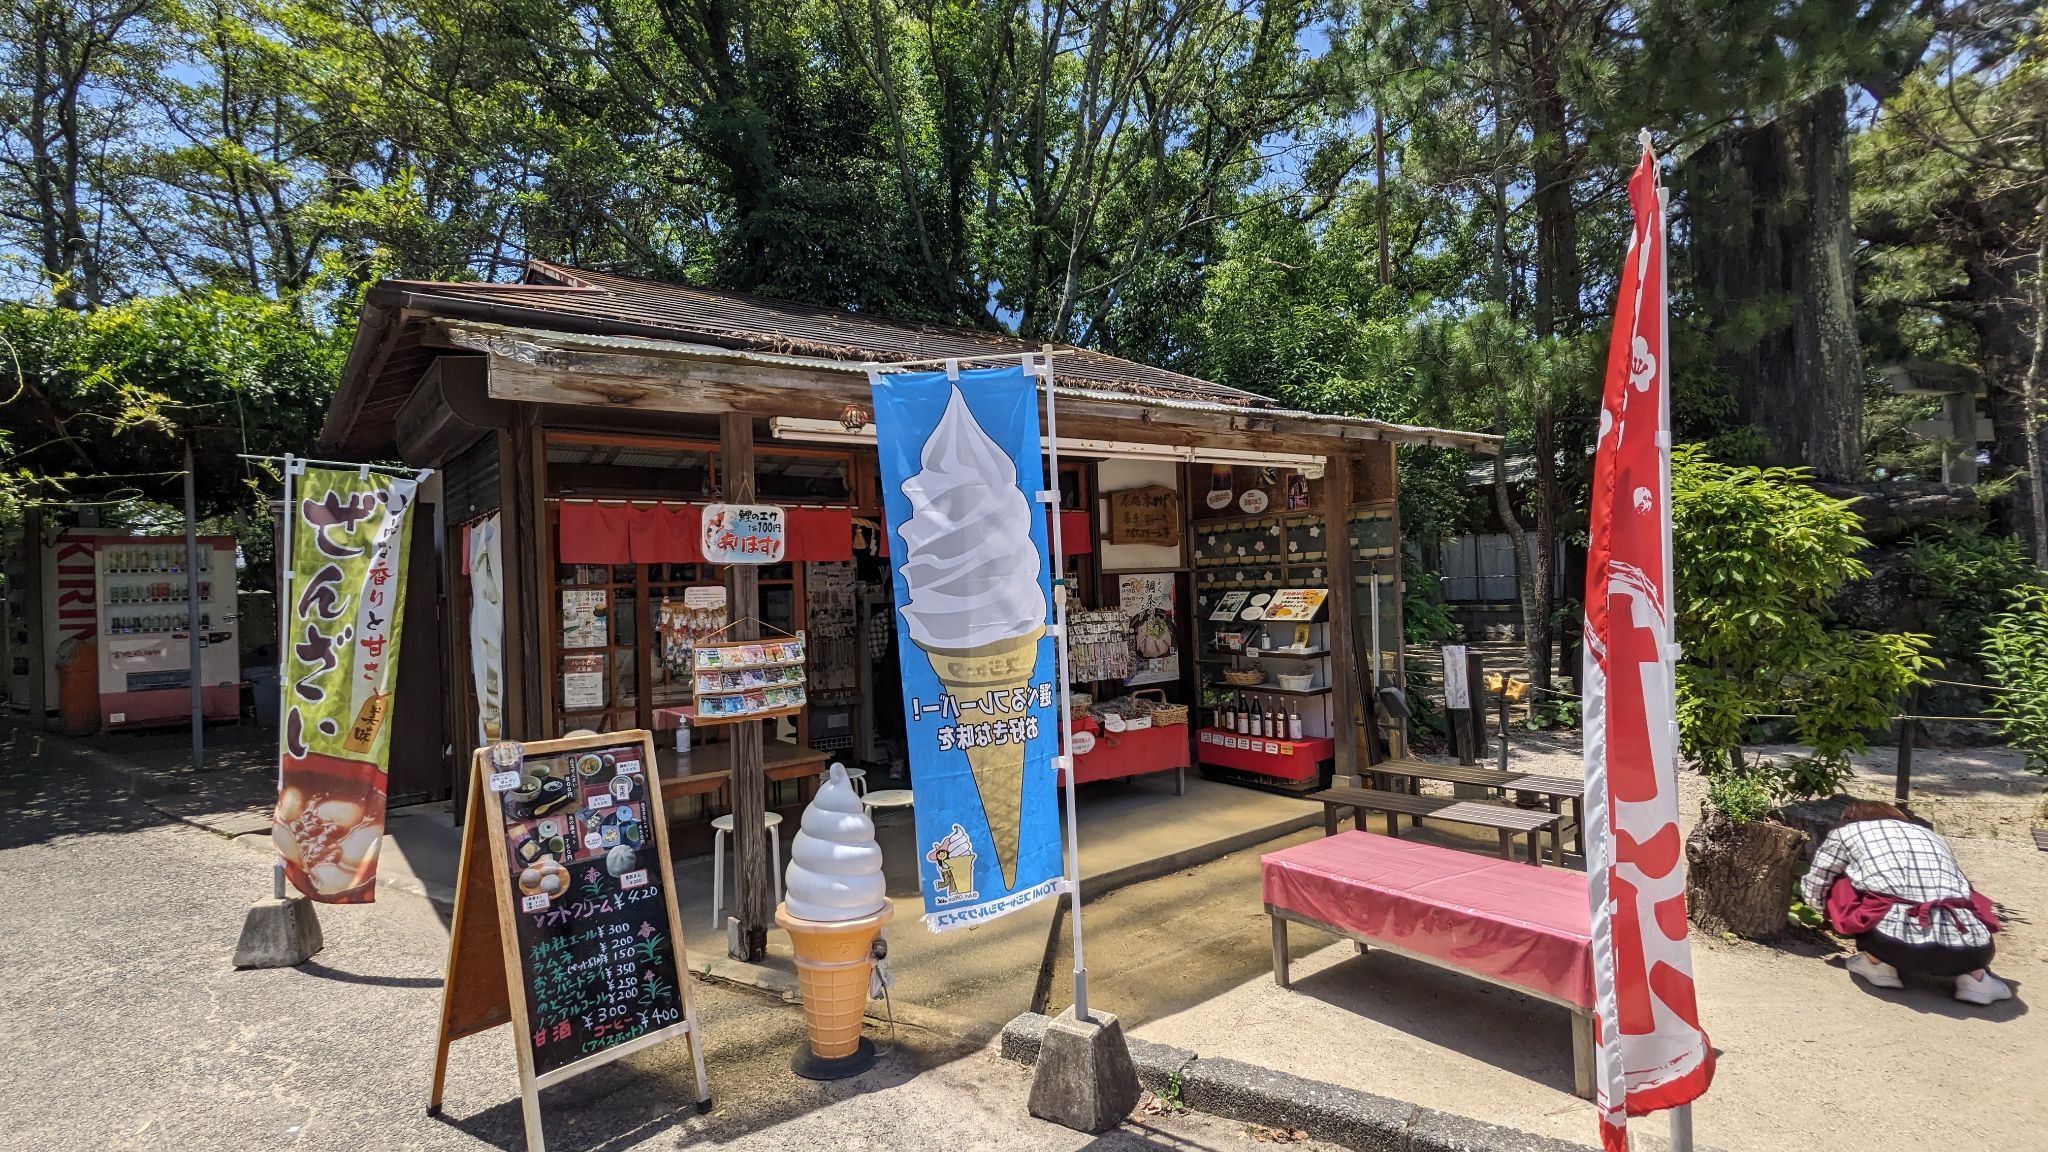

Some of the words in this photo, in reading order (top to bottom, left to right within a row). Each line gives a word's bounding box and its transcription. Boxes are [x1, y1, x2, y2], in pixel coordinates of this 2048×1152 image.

[738, 509, 778, 522] 鯉のエサ
[717, 532, 781, 559] あります!
[56, 535, 97, 641] KIRIN
[533, 899, 614, 928] ソフトクリーム
[613, 886, 658, 911] ¥420
[529, 929, 597, 960] 神社エール
[597, 922, 630, 938] ¥300
[534, 951, 574, 974] ラムネ
[600, 935, 634, 953] ¥200
[534, 967, 566, 990] お茶
[603, 947, 635, 964] ¥150
[536, 966, 606, 1001] スーパードライ
[605, 961, 636, 979] ¥350
[538, 990, 586, 1014] のどごし
[607, 977, 638, 991] ¥250
[539, 991, 608, 1029] ノンアルコール
[608, 986, 639, 1004] ¥200
[532, 1018, 572, 1047] 甘酒
[581, 1004, 628, 1031] ¥300
[593, 1016, 634, 1038] コーヒー
[636, 1007, 679, 1028] ¥400
